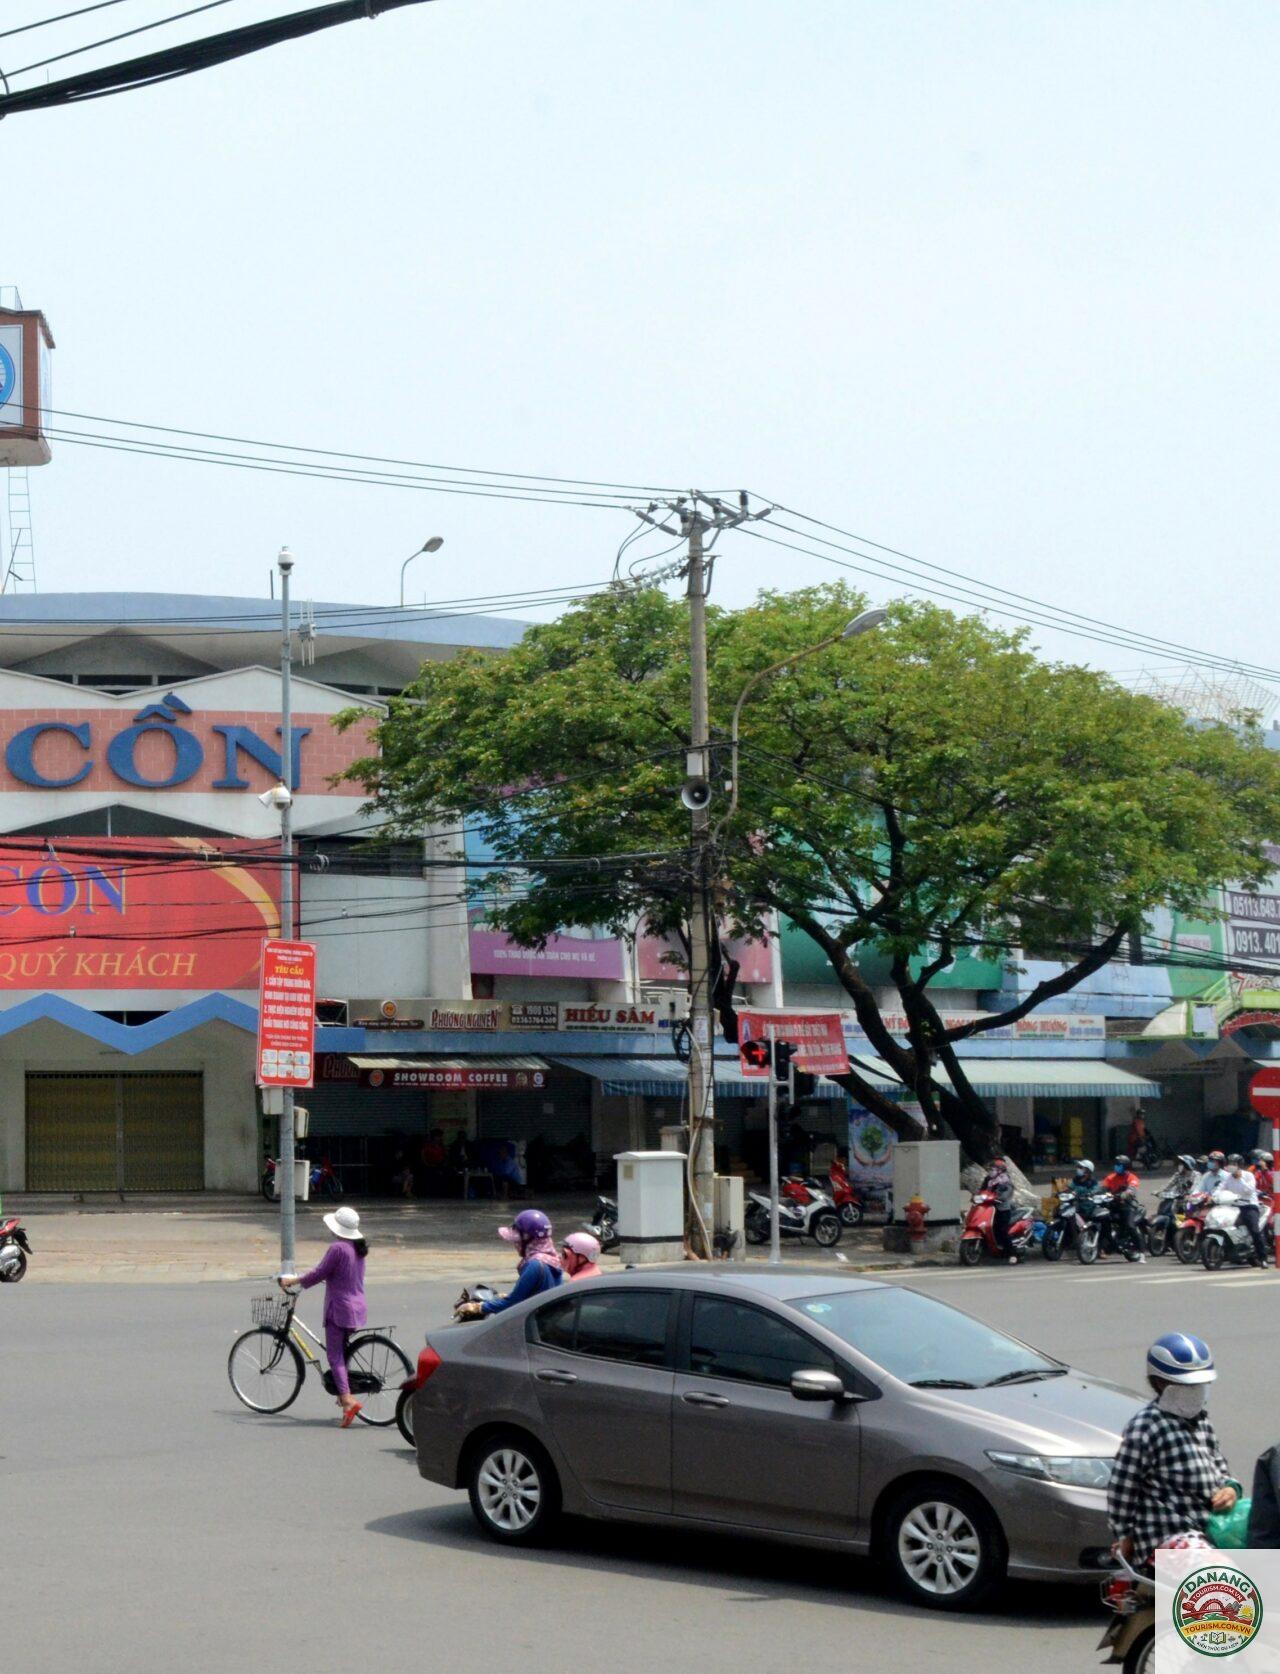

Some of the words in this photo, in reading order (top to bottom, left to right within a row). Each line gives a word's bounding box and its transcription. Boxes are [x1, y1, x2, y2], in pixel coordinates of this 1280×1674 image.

[5, 692, 312, 790] CỒN
[72, 947, 198, 977] KHÁCH
[616, 1006, 655, 1024] SÂM
[394, 1072, 462, 1082] SHOWROOM
[468, 1073, 508, 1083] COFFEE
